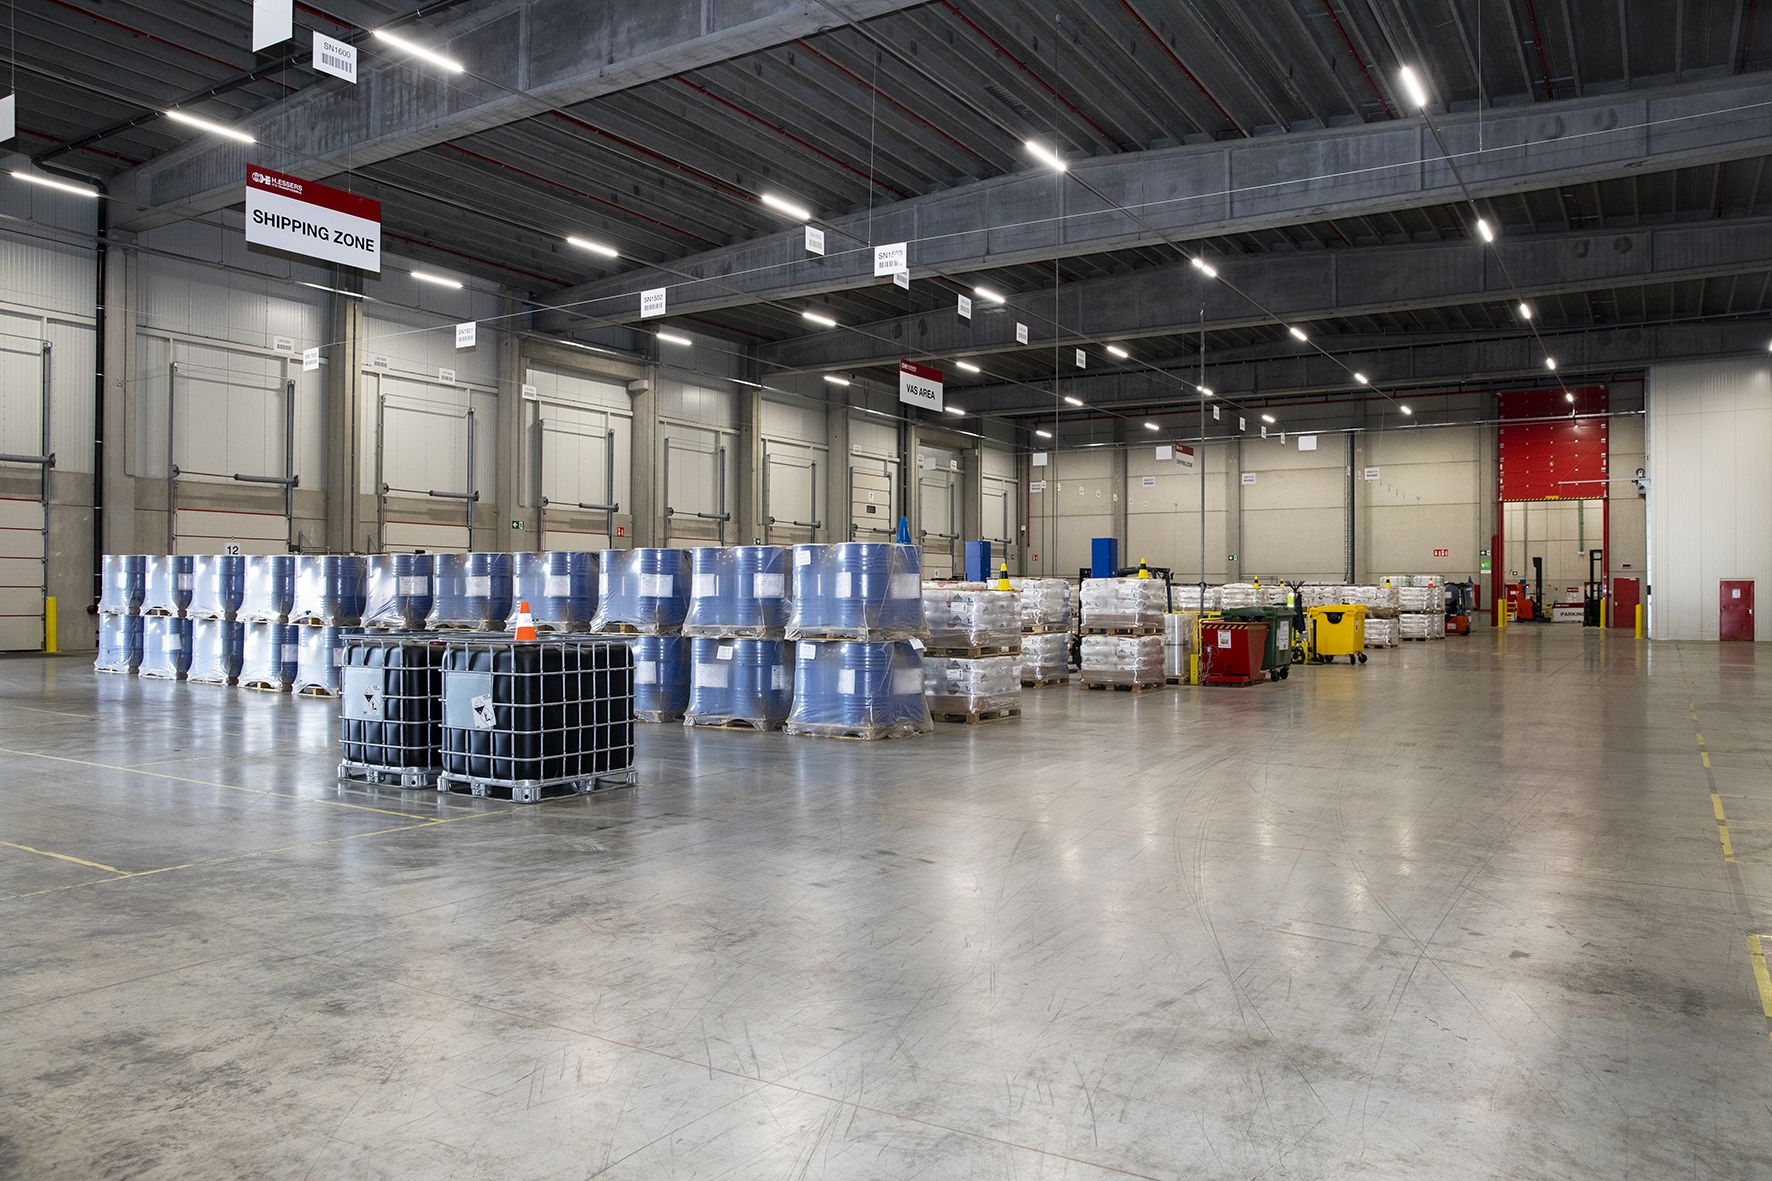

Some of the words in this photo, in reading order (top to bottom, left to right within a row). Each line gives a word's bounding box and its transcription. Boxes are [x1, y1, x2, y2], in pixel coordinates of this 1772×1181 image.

[323, 41, 352, 59] SN1600
[271, 177, 303, 191] H.ESSERS
[252, 208, 329, 241] SHIPPING
[333, 230, 375, 253] ZONE
[906, 383, 918, 396] VAS
[919, 387, 936, 400] AREA
[227, 545, 239, 555] 12
